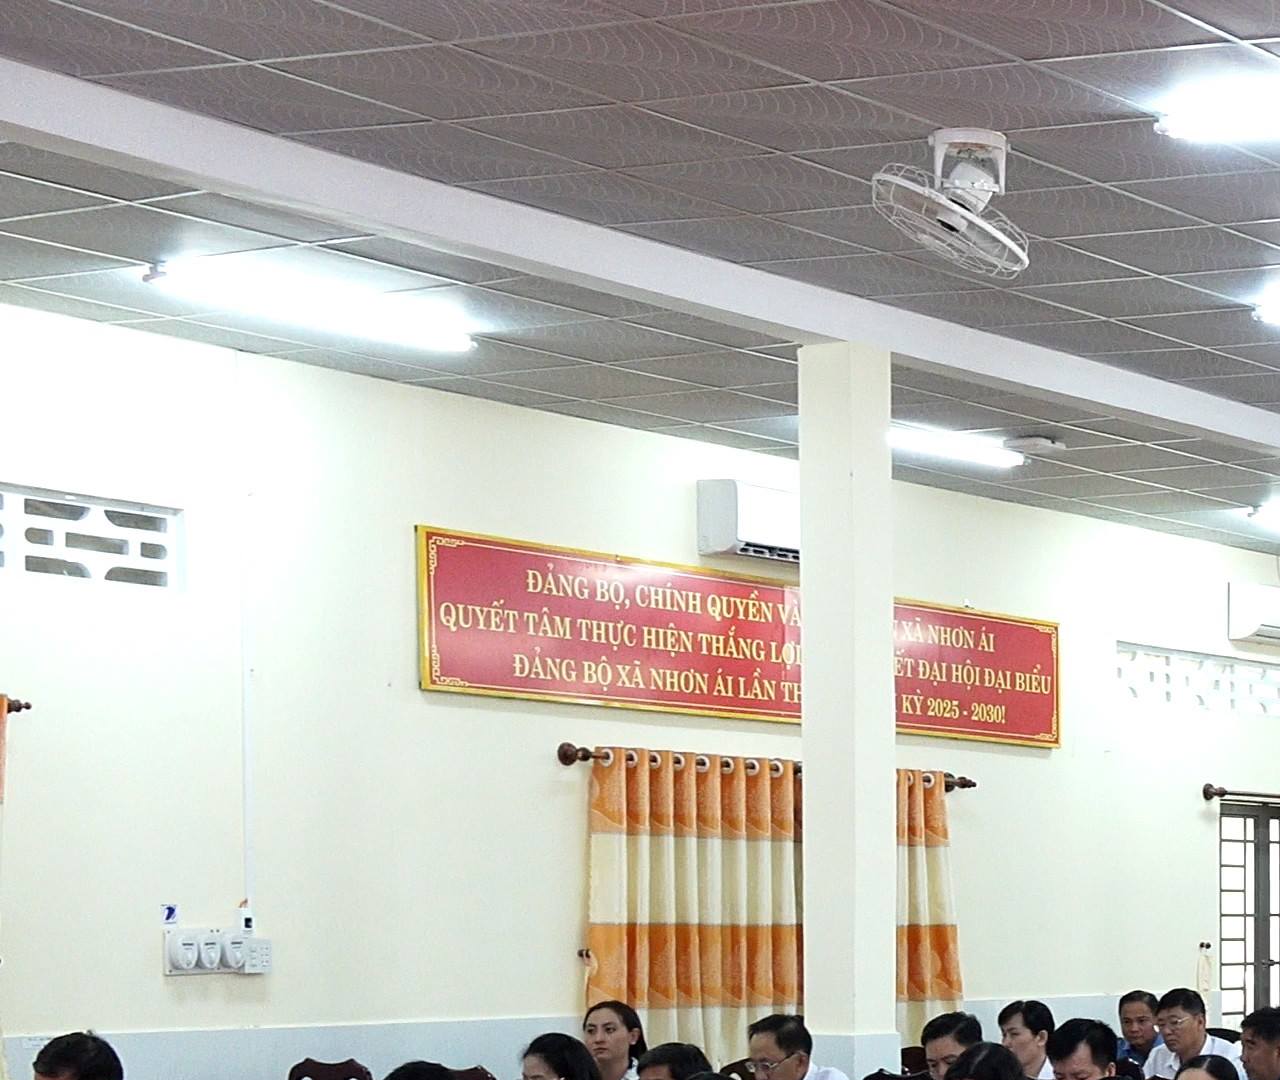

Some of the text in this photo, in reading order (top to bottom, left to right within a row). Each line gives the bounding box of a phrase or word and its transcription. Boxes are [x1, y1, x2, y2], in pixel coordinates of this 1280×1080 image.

[527, 563, 589, 599] ĐẢNG
[635, 583, 701, 614] CHÍNH
[707, 590, 773, 623] QUYỀN
[778, 600, 801, 627] VÀ
[440, 600, 801, 670] QUYẾT TÂM THỰC HIỆN THẮNG LỢI
[902, 617, 924, 643] XÃ
[928, 625, 975, 649] NHƠN
[979, 627, 995, 652] ÁI
[513, 646, 801, 703] ĐẢNG BỘ XÃ NHƠN ÁI LẦN TH
[918, 660, 947, 686] ĐẠI
[952, 660, 981, 691] HỘI
[984, 668, 1012, 694] ĐẠI
[1015, 664, 1052, 695] BIỂU
[902, 689, 924, 715] KỲ
[928, 698, 960, 718] 2025
[971, 703, 1006, 724] 2030!
